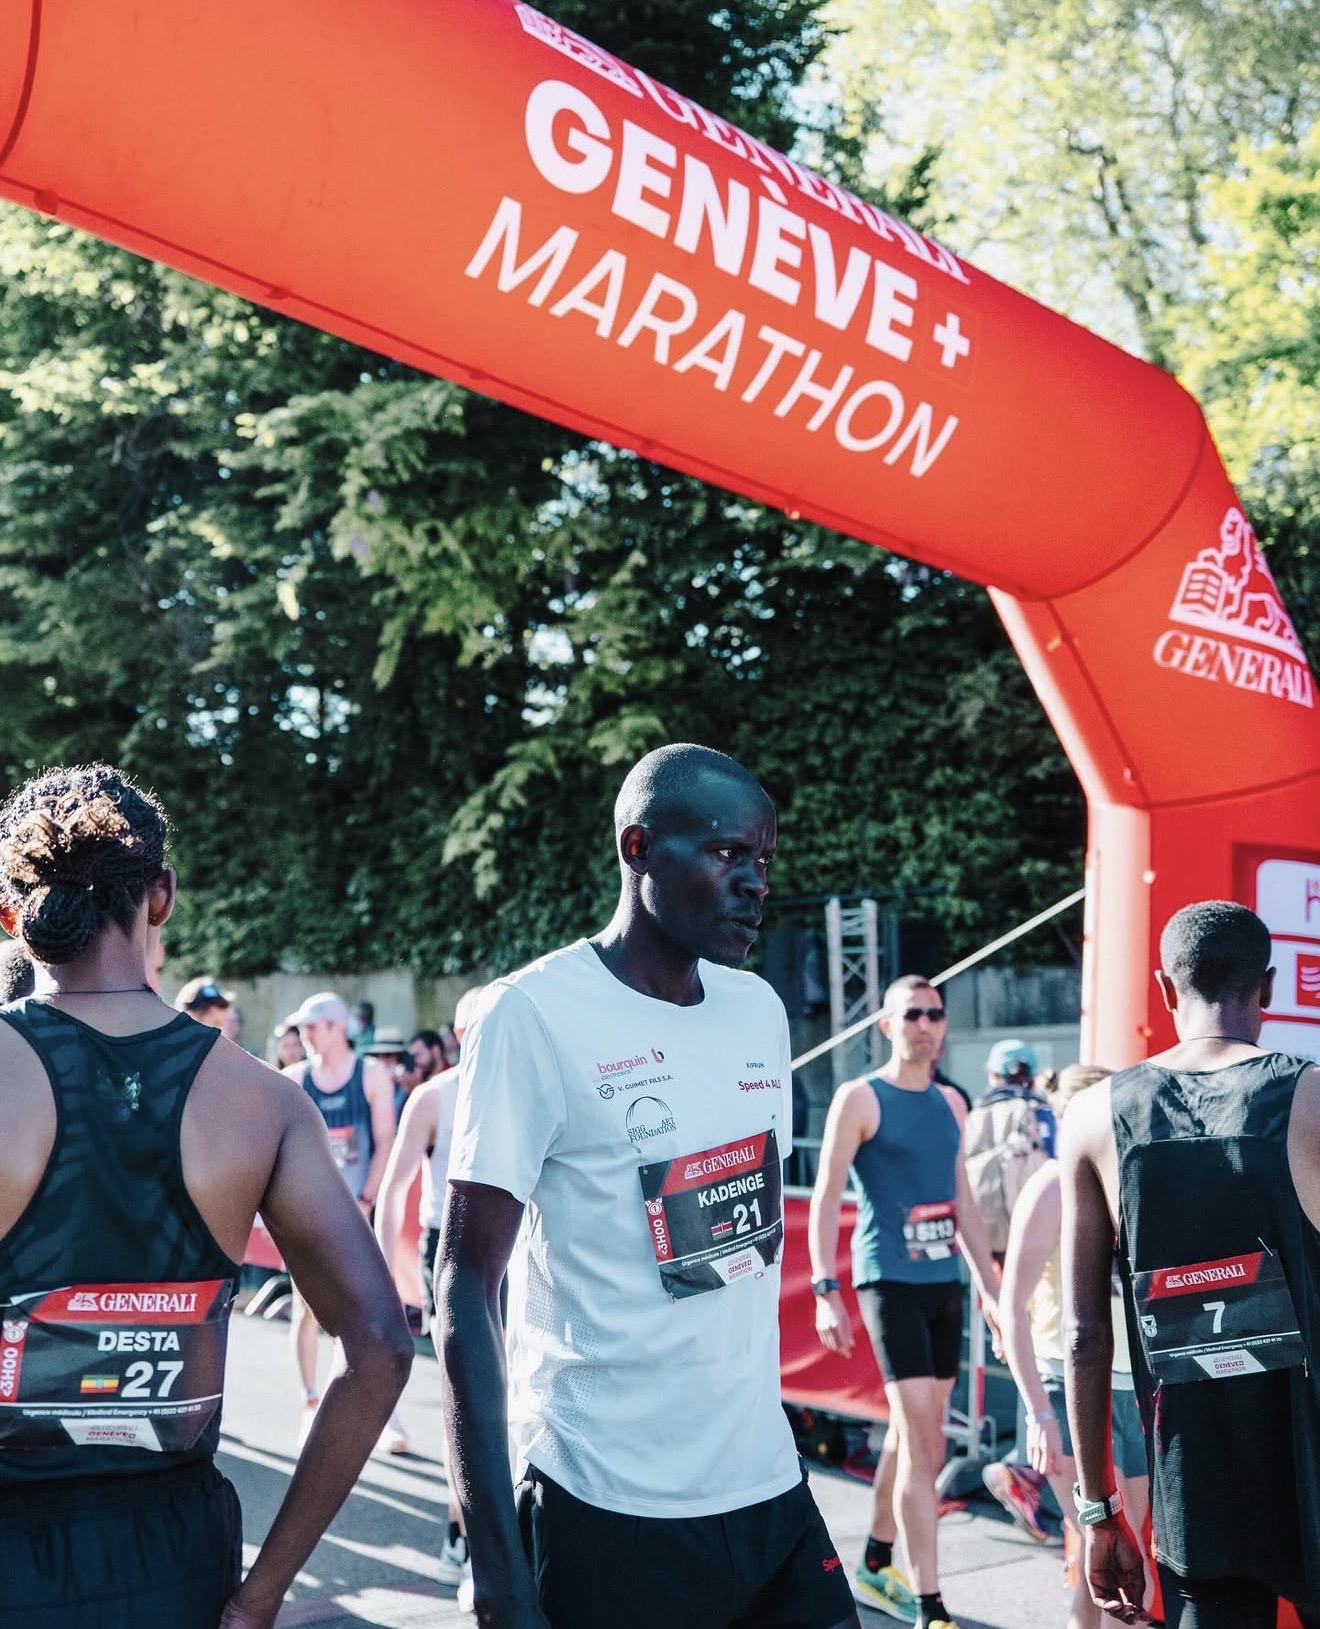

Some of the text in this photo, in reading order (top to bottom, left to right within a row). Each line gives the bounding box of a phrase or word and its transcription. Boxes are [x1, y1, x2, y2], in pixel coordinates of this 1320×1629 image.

[525, 79, 918, 362] GENÈVE
[464, 196, 960, 478] MARATHON
[1153, 629, 1314, 709] GENERALI
[597, 1055, 648, 1075] bourquin
[625, 1079, 648, 1090] GUIMET
[648, 1076, 662, 1085] FILS
[738, 1079, 765, 1093] Speed
[765, 1079, 771, 1089] 4
[626, 1116, 675, 1136] SIGG ART
[630, 1121, 677, 1144] FOUNDATION
[702, 1145, 756, 1174] GENERALI
[697, 1172, 765, 1209] KADENGE
[732, 1198, 763, 1235] 21
[1183, 1263, 1247, 1286] GENERALI
[100, 1292, 198, 1313] GENERALI
[1202, 1300, 1226, 1334] 7
[97, 1330, 181, 1352] DESTA
[120, 1360, 184, 1398] 27
